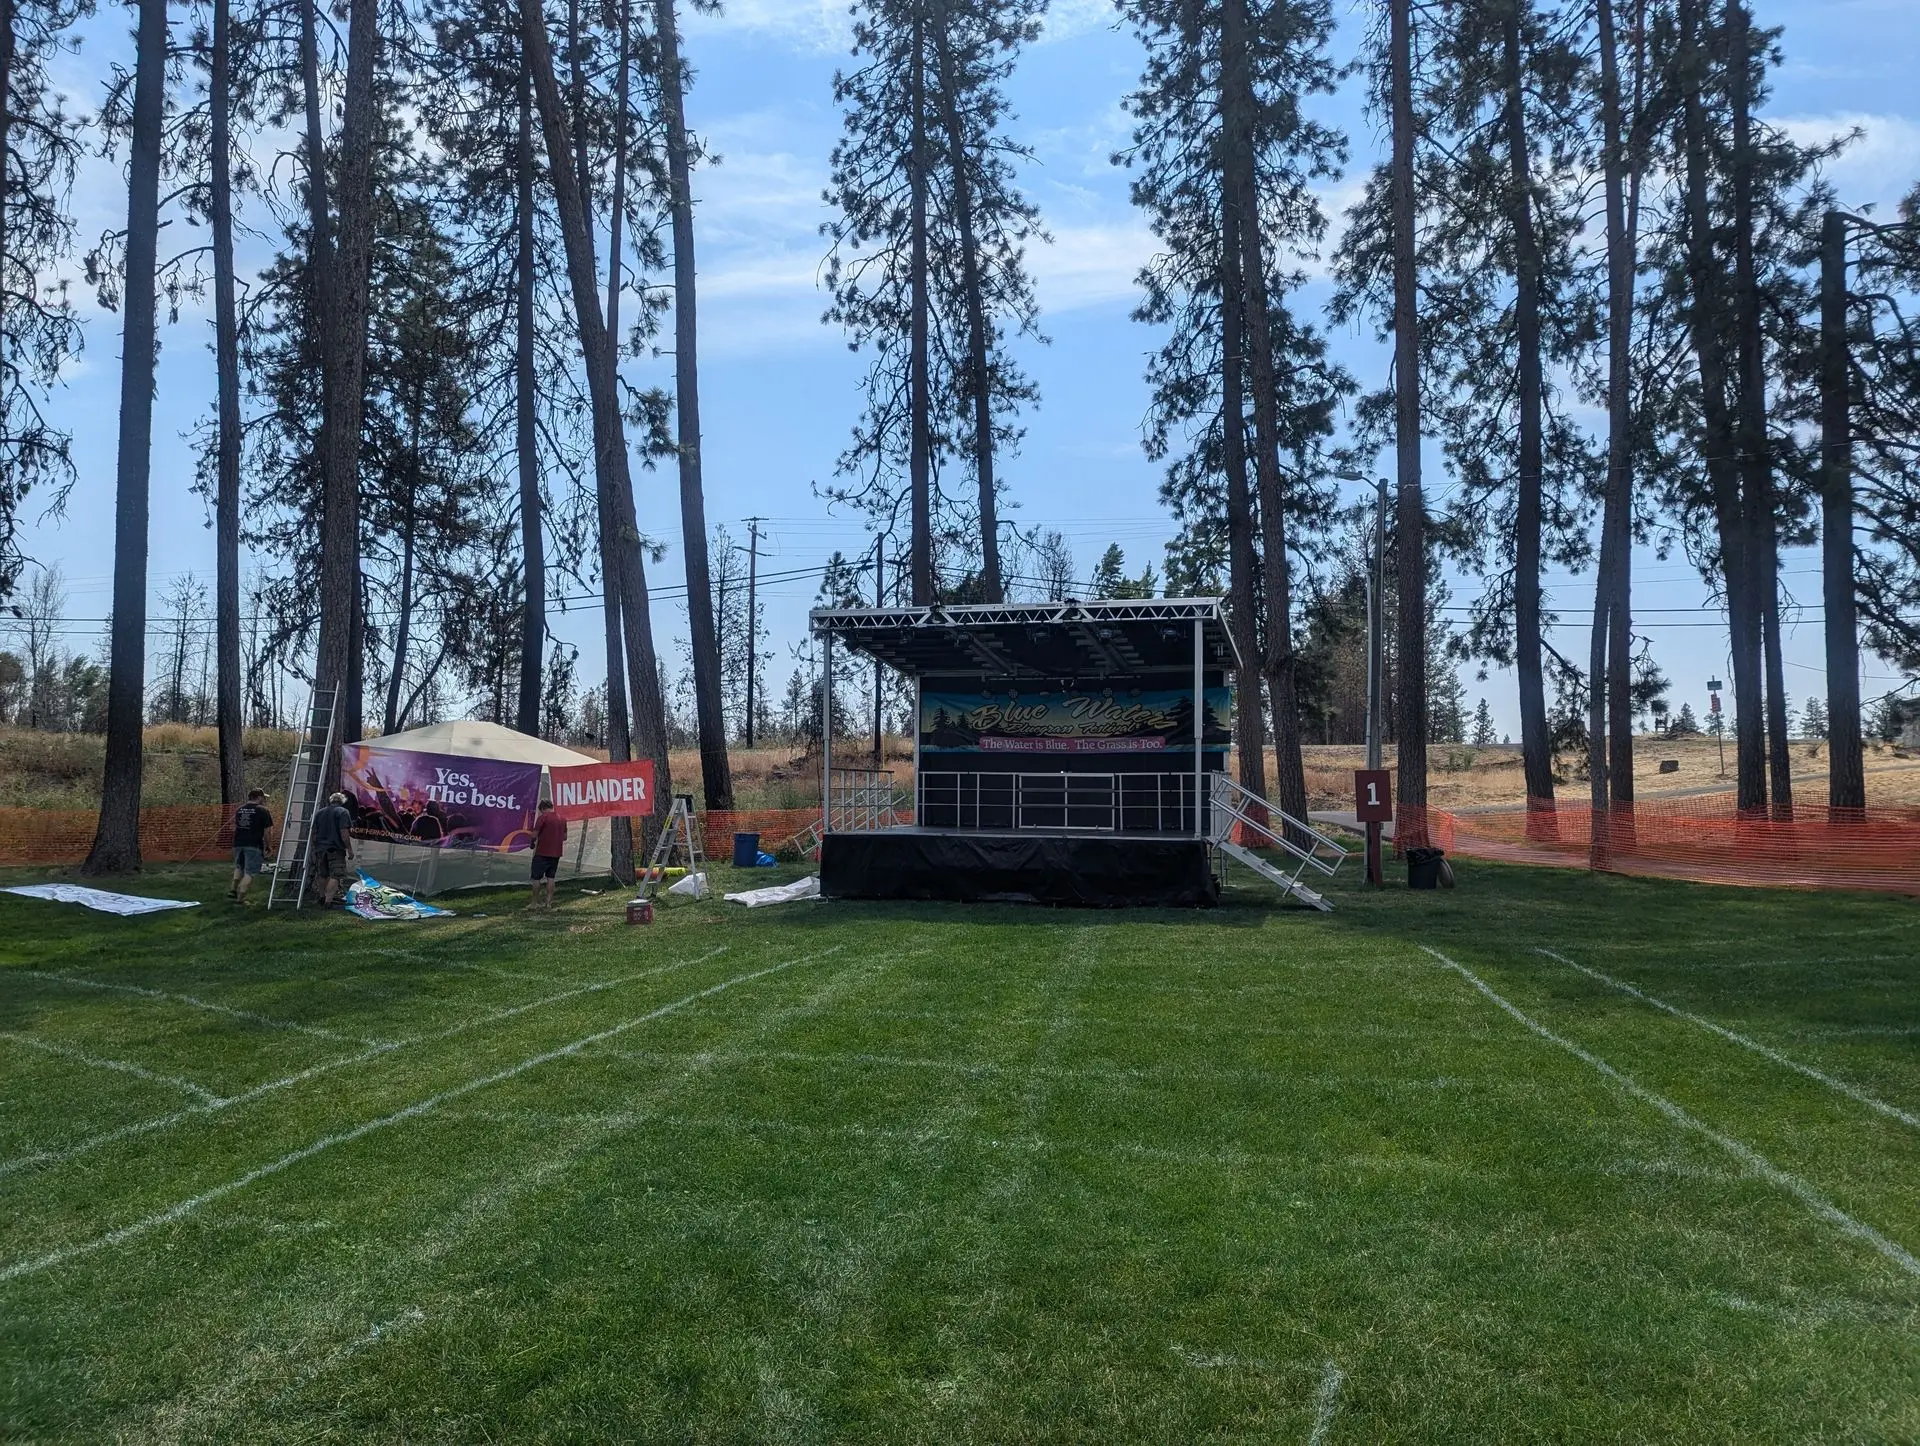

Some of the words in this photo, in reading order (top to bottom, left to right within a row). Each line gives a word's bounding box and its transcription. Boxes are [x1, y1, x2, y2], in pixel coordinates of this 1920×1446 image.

[971, 701, 1049, 730] Blue
[1062, 697, 1178, 729] Water
[1002, 721, 1074, 735] Bluegrass
[983, 739, 1002, 749] The
[1004, 740, 1031, 750] Water
[1034, 740, 1044, 750] is
[1046, 740, 1070, 751] Blue.
[1075, 740, 1095, 750] The
[1097, 740, 1127, 750] Grass
[1129, 740, 1138, 750] is
[1140, 739, 1163, 749] Too.
[435, 767, 475, 788] Yes.
[425, 785, 467, 804] The
[470, 788, 521, 810] best.
[556, 777, 646, 806] INLANDER
[1367, 782, 1380, 806] 1
